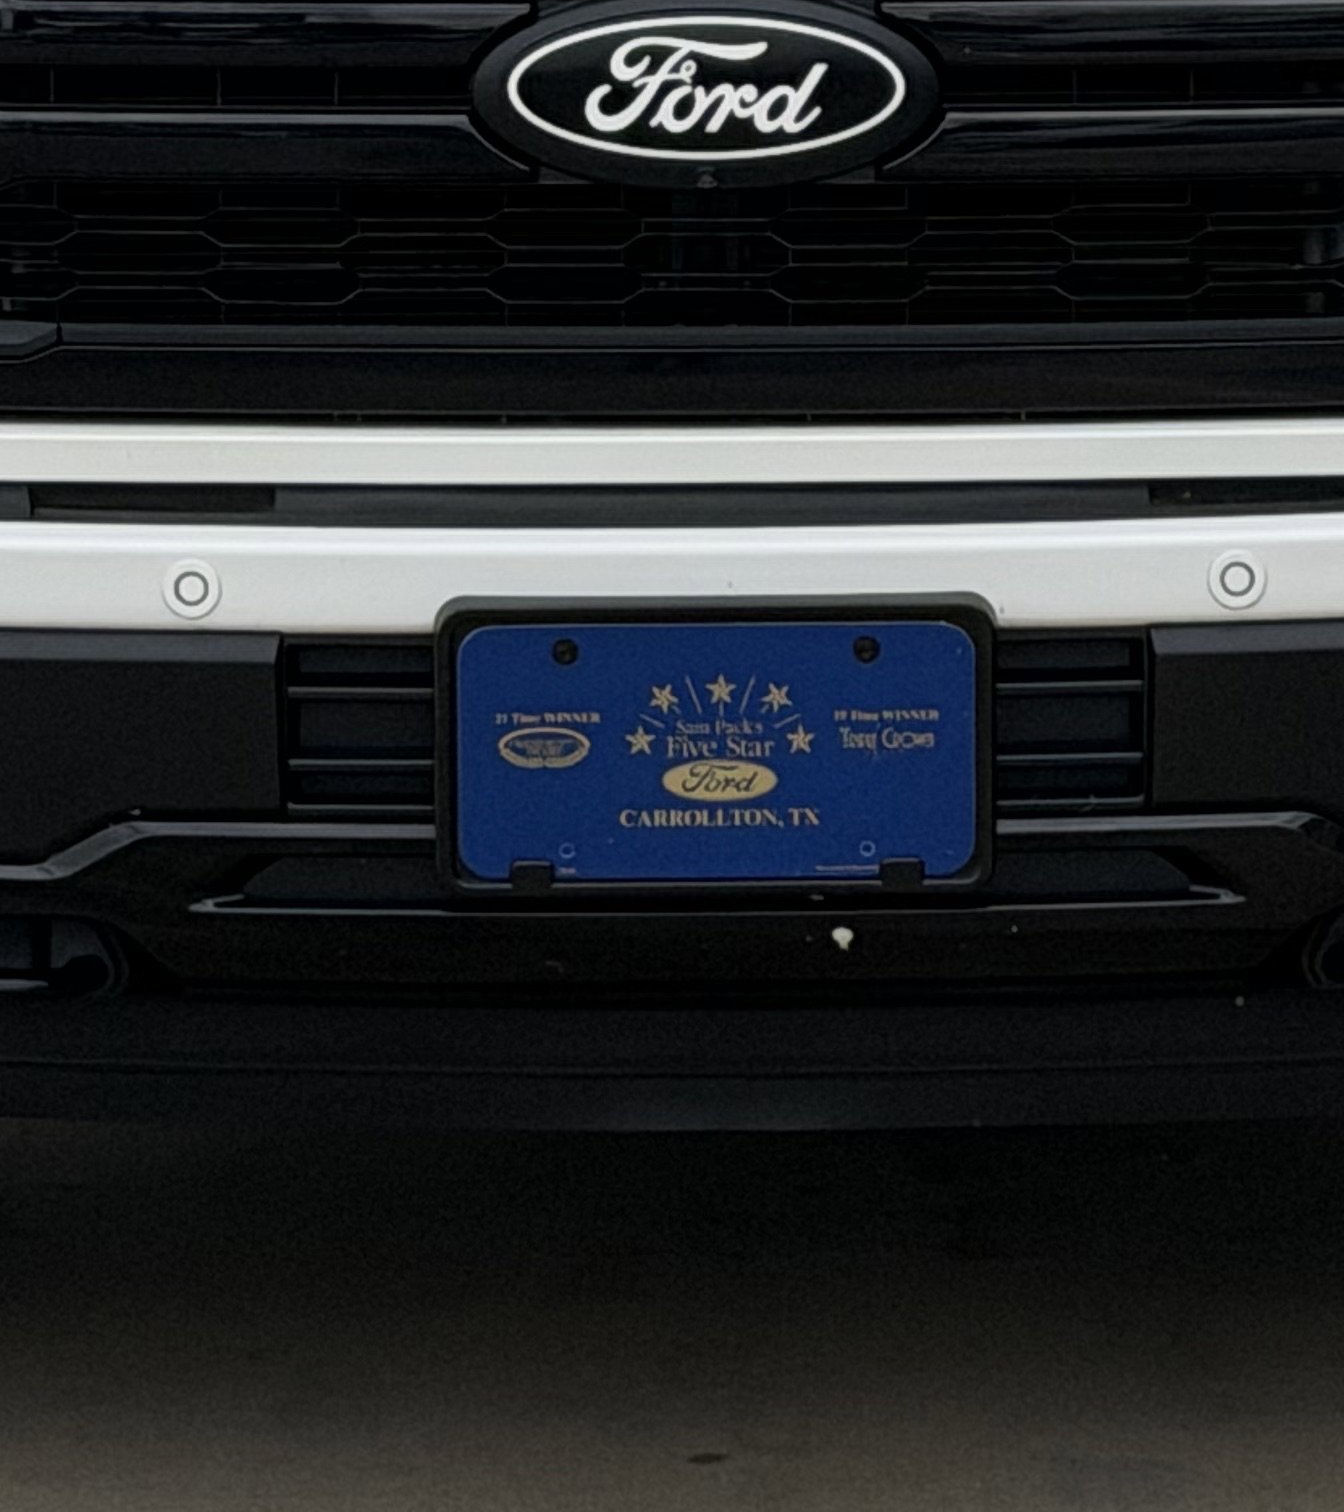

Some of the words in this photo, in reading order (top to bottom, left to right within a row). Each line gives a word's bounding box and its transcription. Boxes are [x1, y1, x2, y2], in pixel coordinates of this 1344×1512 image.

[584, 36, 829, 133] Ford
[667, 736, 717, 758] Five
[726, 736, 775, 757] Star
[682, 763, 758, 793] Ford
[788, 807, 820, 826] TX
